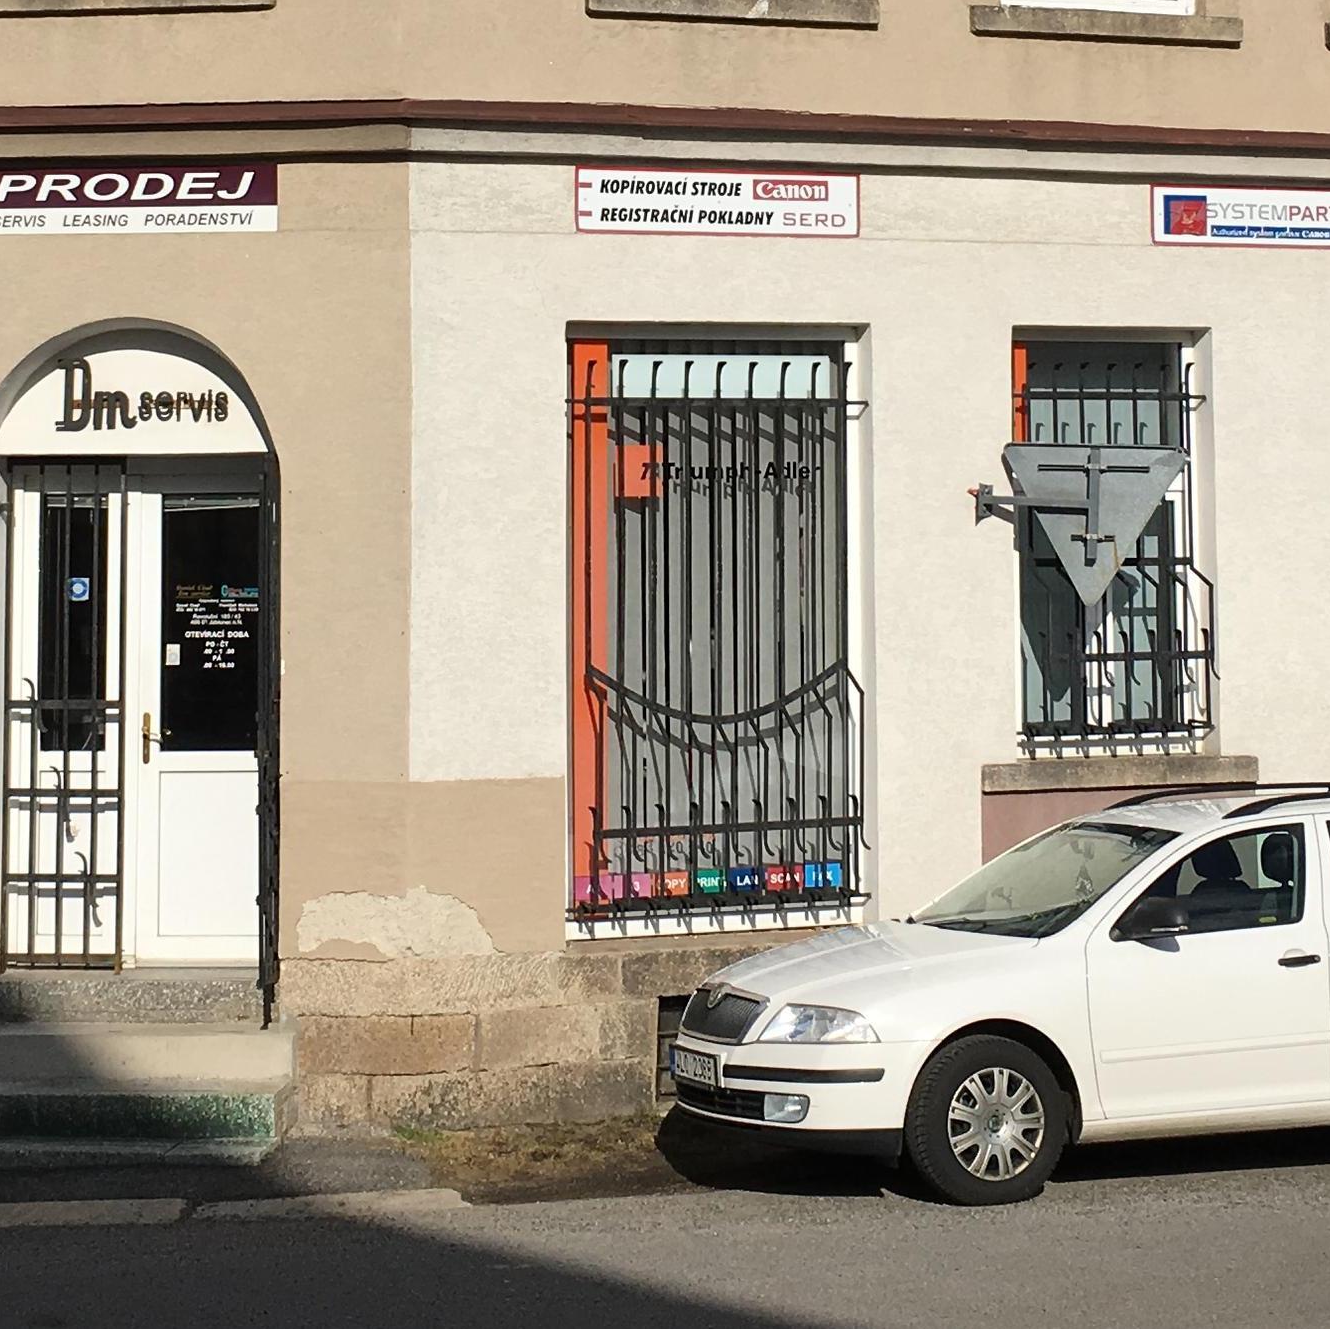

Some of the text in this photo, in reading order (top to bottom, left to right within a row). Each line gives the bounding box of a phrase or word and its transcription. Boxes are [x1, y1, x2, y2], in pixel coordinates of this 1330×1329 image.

[600, 175, 827, 199] KOPÍROVACÍ STROJE Canon
[62, 214, 128, 227] LEASING
[144, 210, 253, 226] PORADENSTVÍ
[600, 205, 846, 228] REGISTRAČNÍ POKLADNY SERD
[737, 875, 758, 886] LAN
